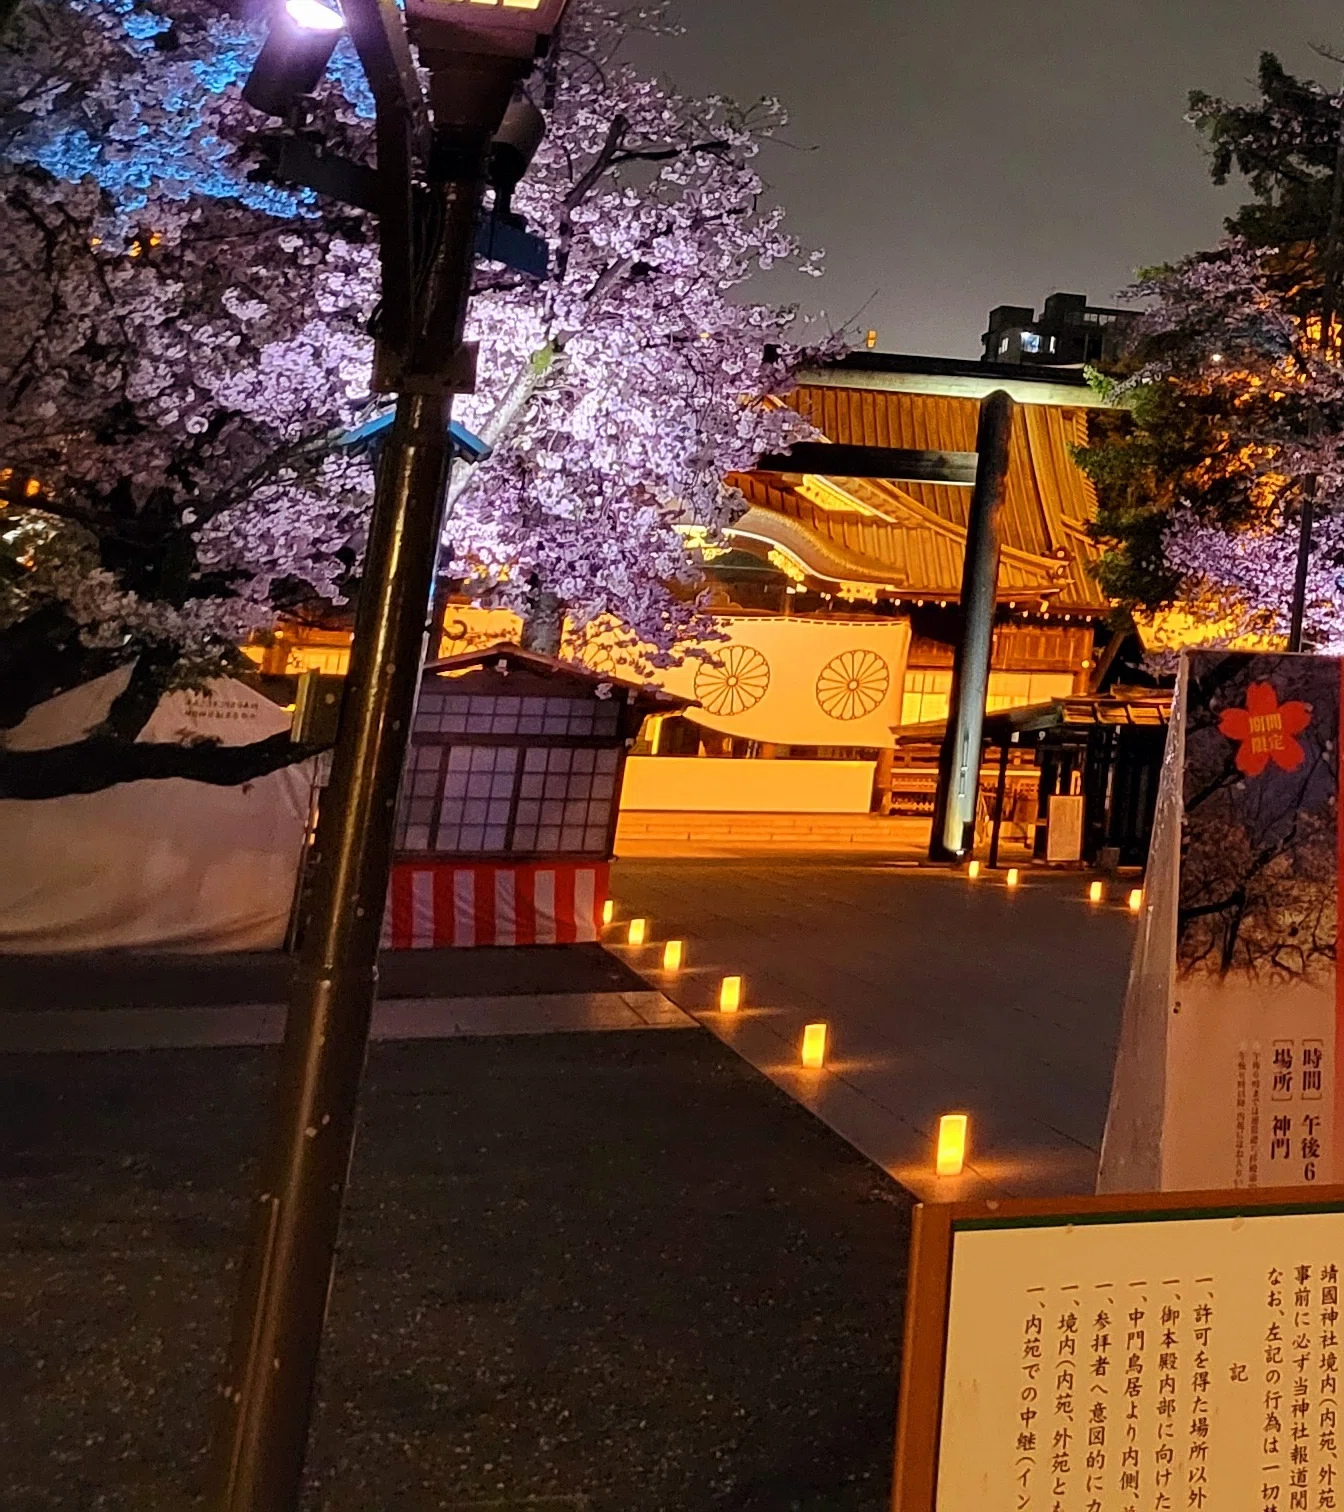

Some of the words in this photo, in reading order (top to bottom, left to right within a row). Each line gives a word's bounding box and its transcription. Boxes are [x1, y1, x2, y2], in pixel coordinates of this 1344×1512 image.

[1270, 1114, 1291, 1160] 神門
[1301, 1114, 1321, 1181] 午後6
[1155, 1280, 1181, 1510] 一、御本殿内部に向けた
[1188, 1277, 1214, 1509] 一、許可を得た場所以外
[1229, 1363, 1249, 1382] 記
[1289, 1264, 1312, 1510] 事前に必ず当神社報道関
